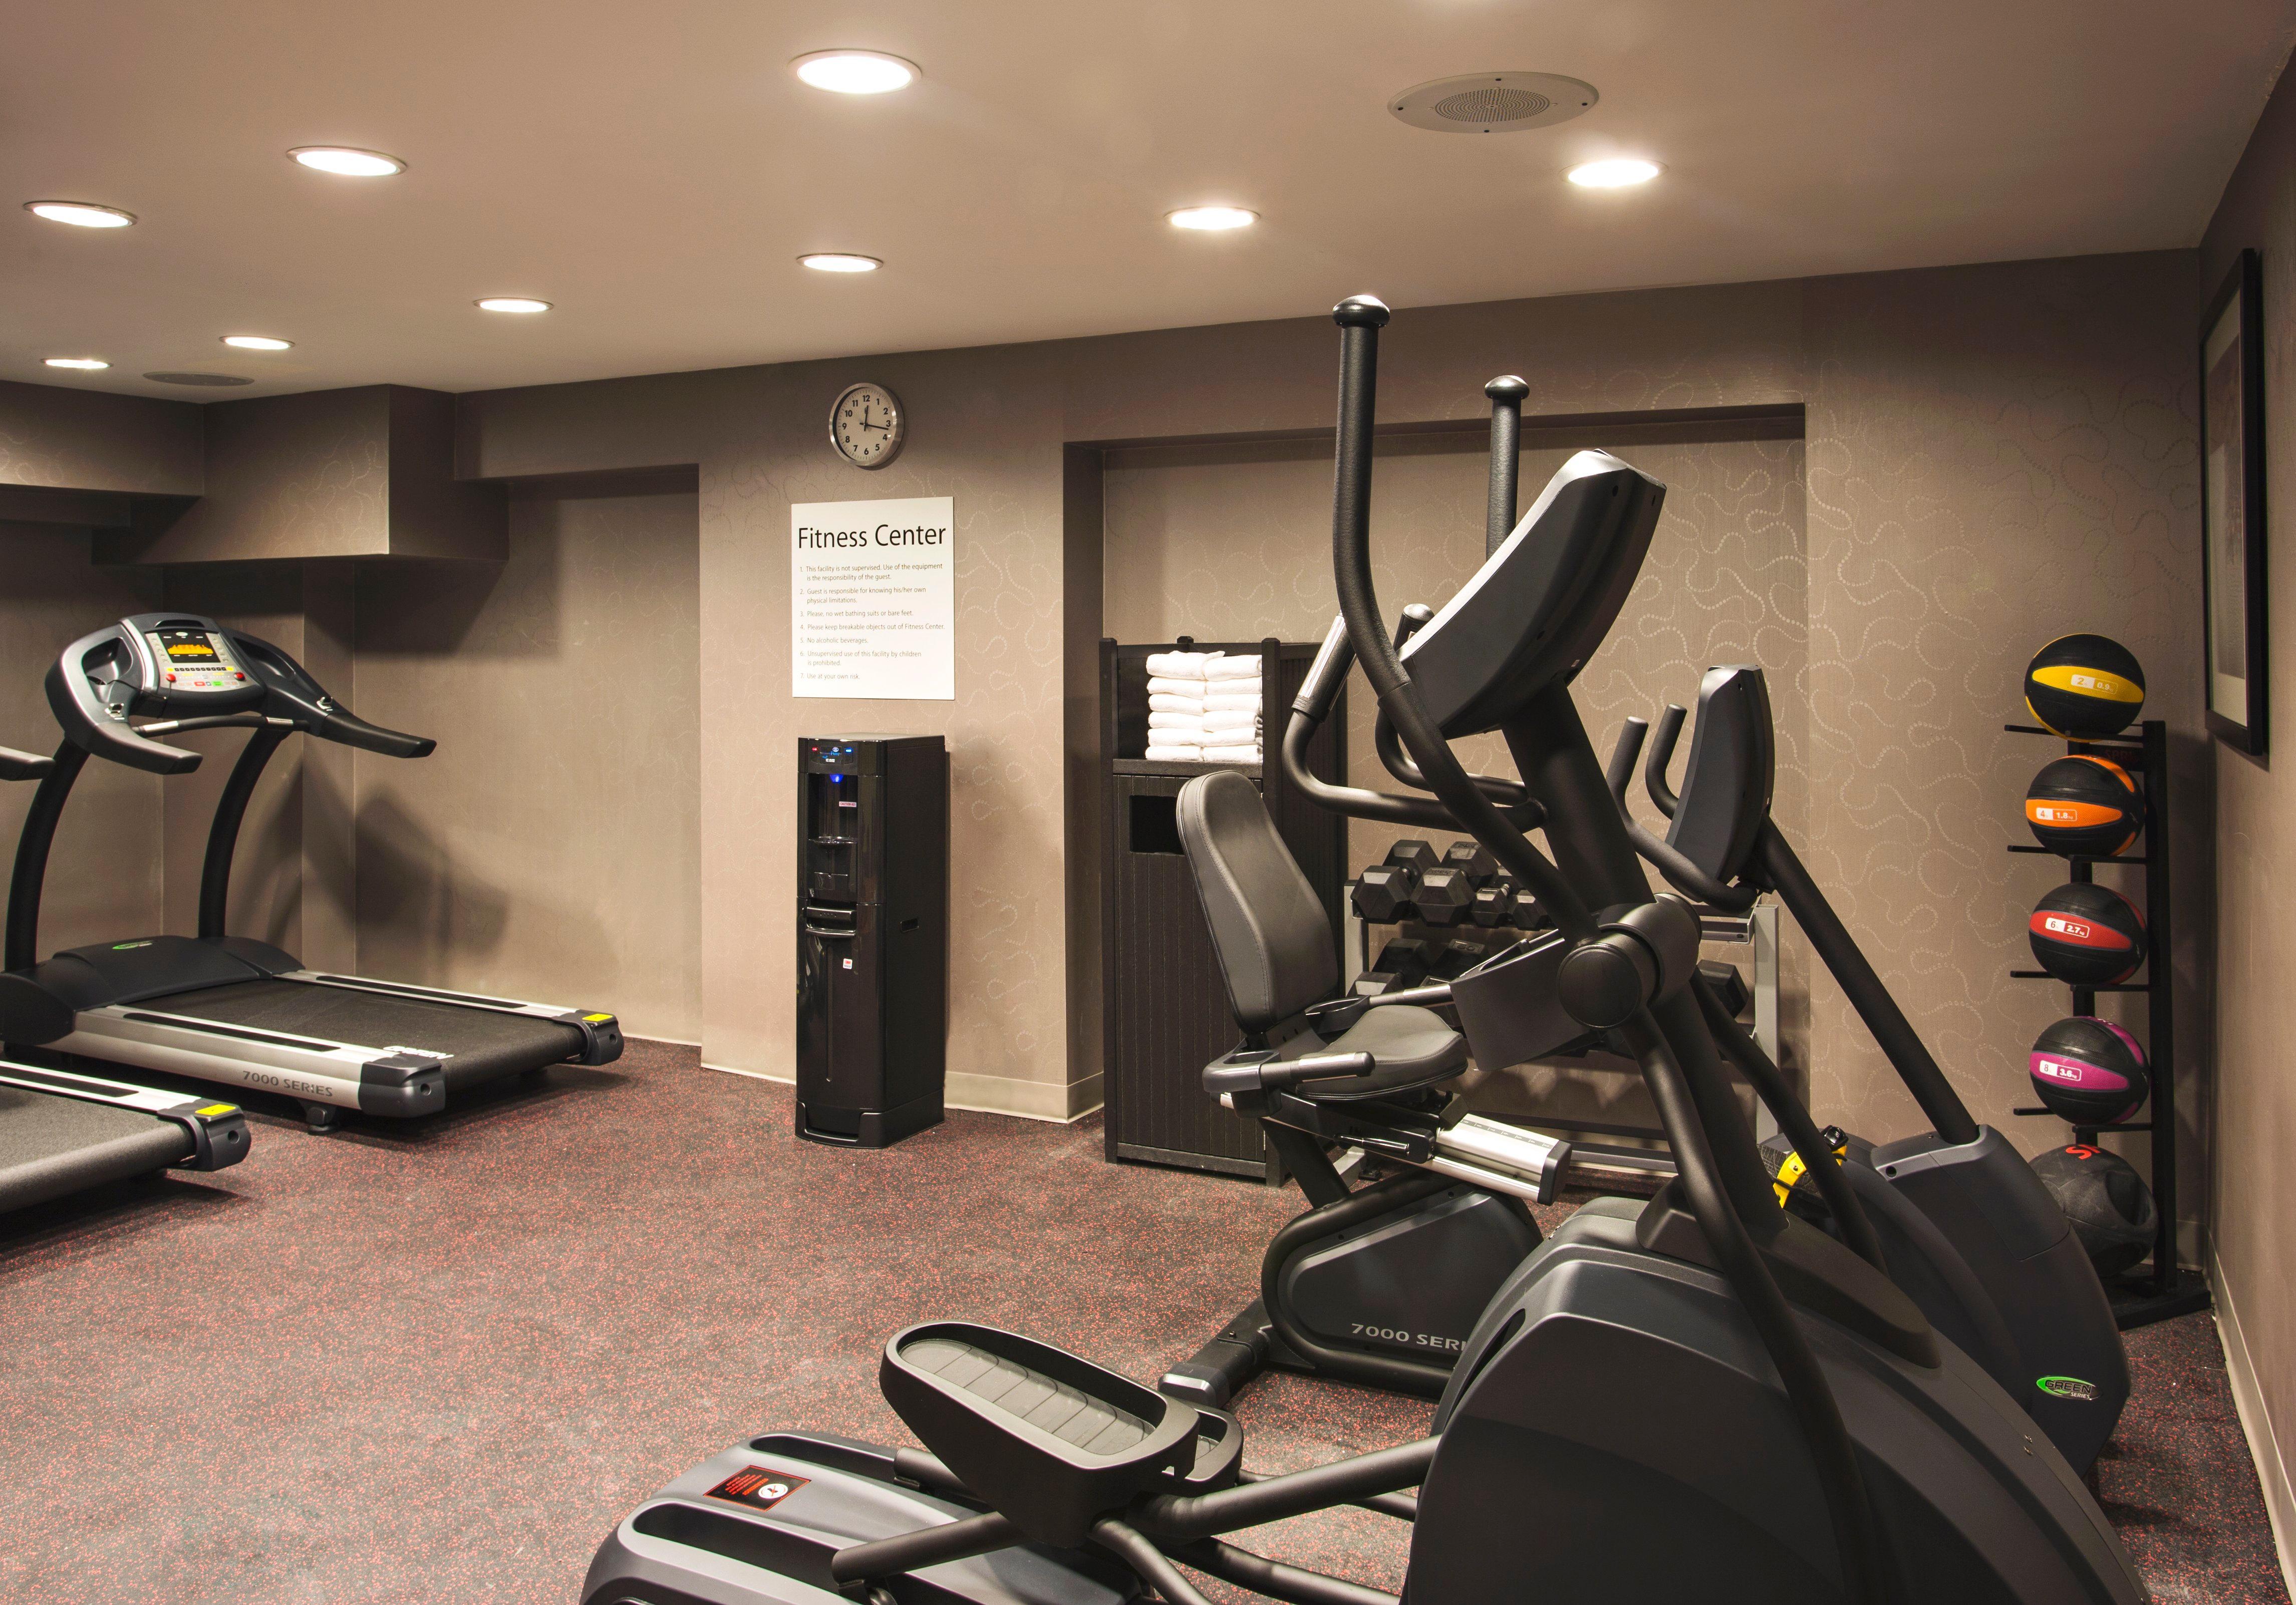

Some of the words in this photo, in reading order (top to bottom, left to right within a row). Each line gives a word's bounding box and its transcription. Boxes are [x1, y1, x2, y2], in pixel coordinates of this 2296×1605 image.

[799, 527, 867, 548] Fitness
[876, 524, 946, 546] Center
[243, 1071, 279, 1086] 7000
[283, 1079, 333, 1097] SERIES
[1352, 1323, 1409, 1342] 7000
[1416, 1334, 1467, 1351] SERI
[2045, 1380, 2093, 1394] GREEN
